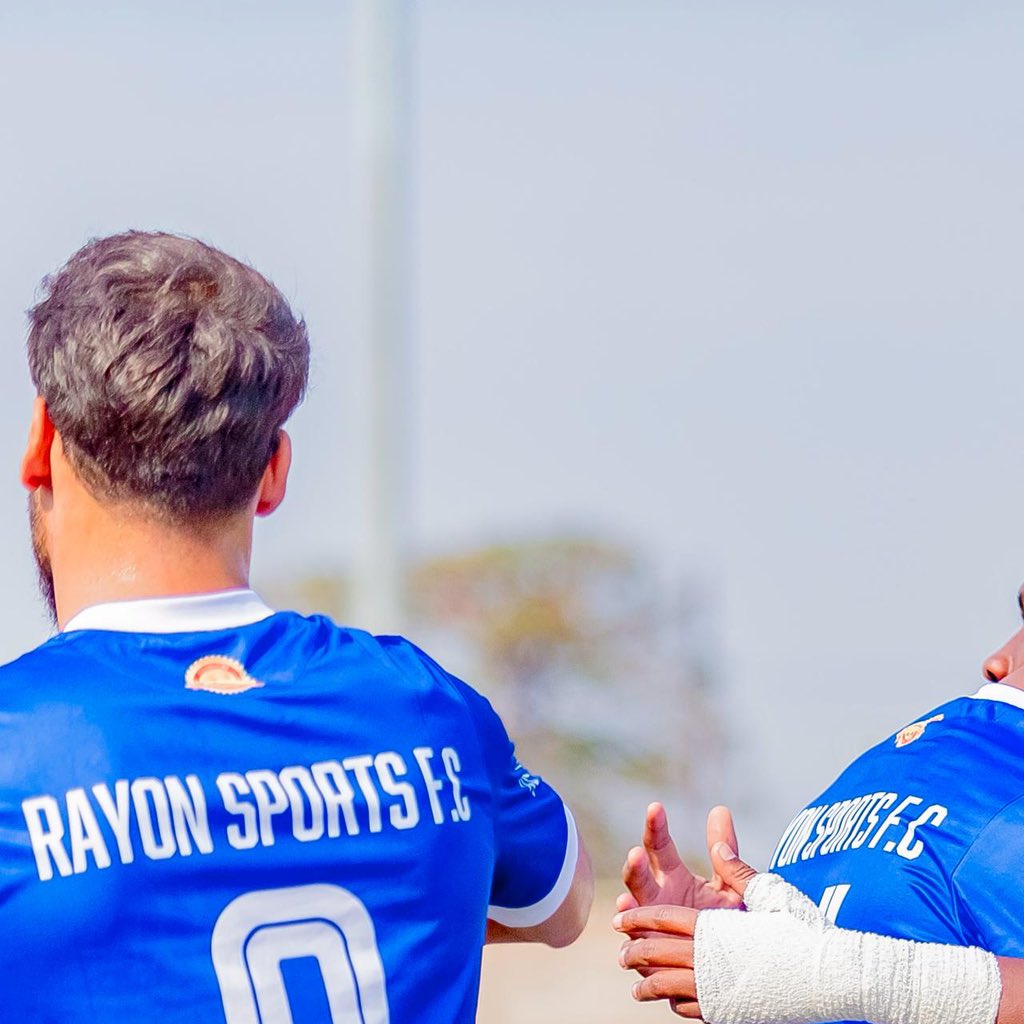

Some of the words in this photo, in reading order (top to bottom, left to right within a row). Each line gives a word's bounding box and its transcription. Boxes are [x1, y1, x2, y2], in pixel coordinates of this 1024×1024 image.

[22, 774, 214, 881] RAYON
[216, 749, 420, 850] SPORTS
[413, 746, 472, 824] F.C
